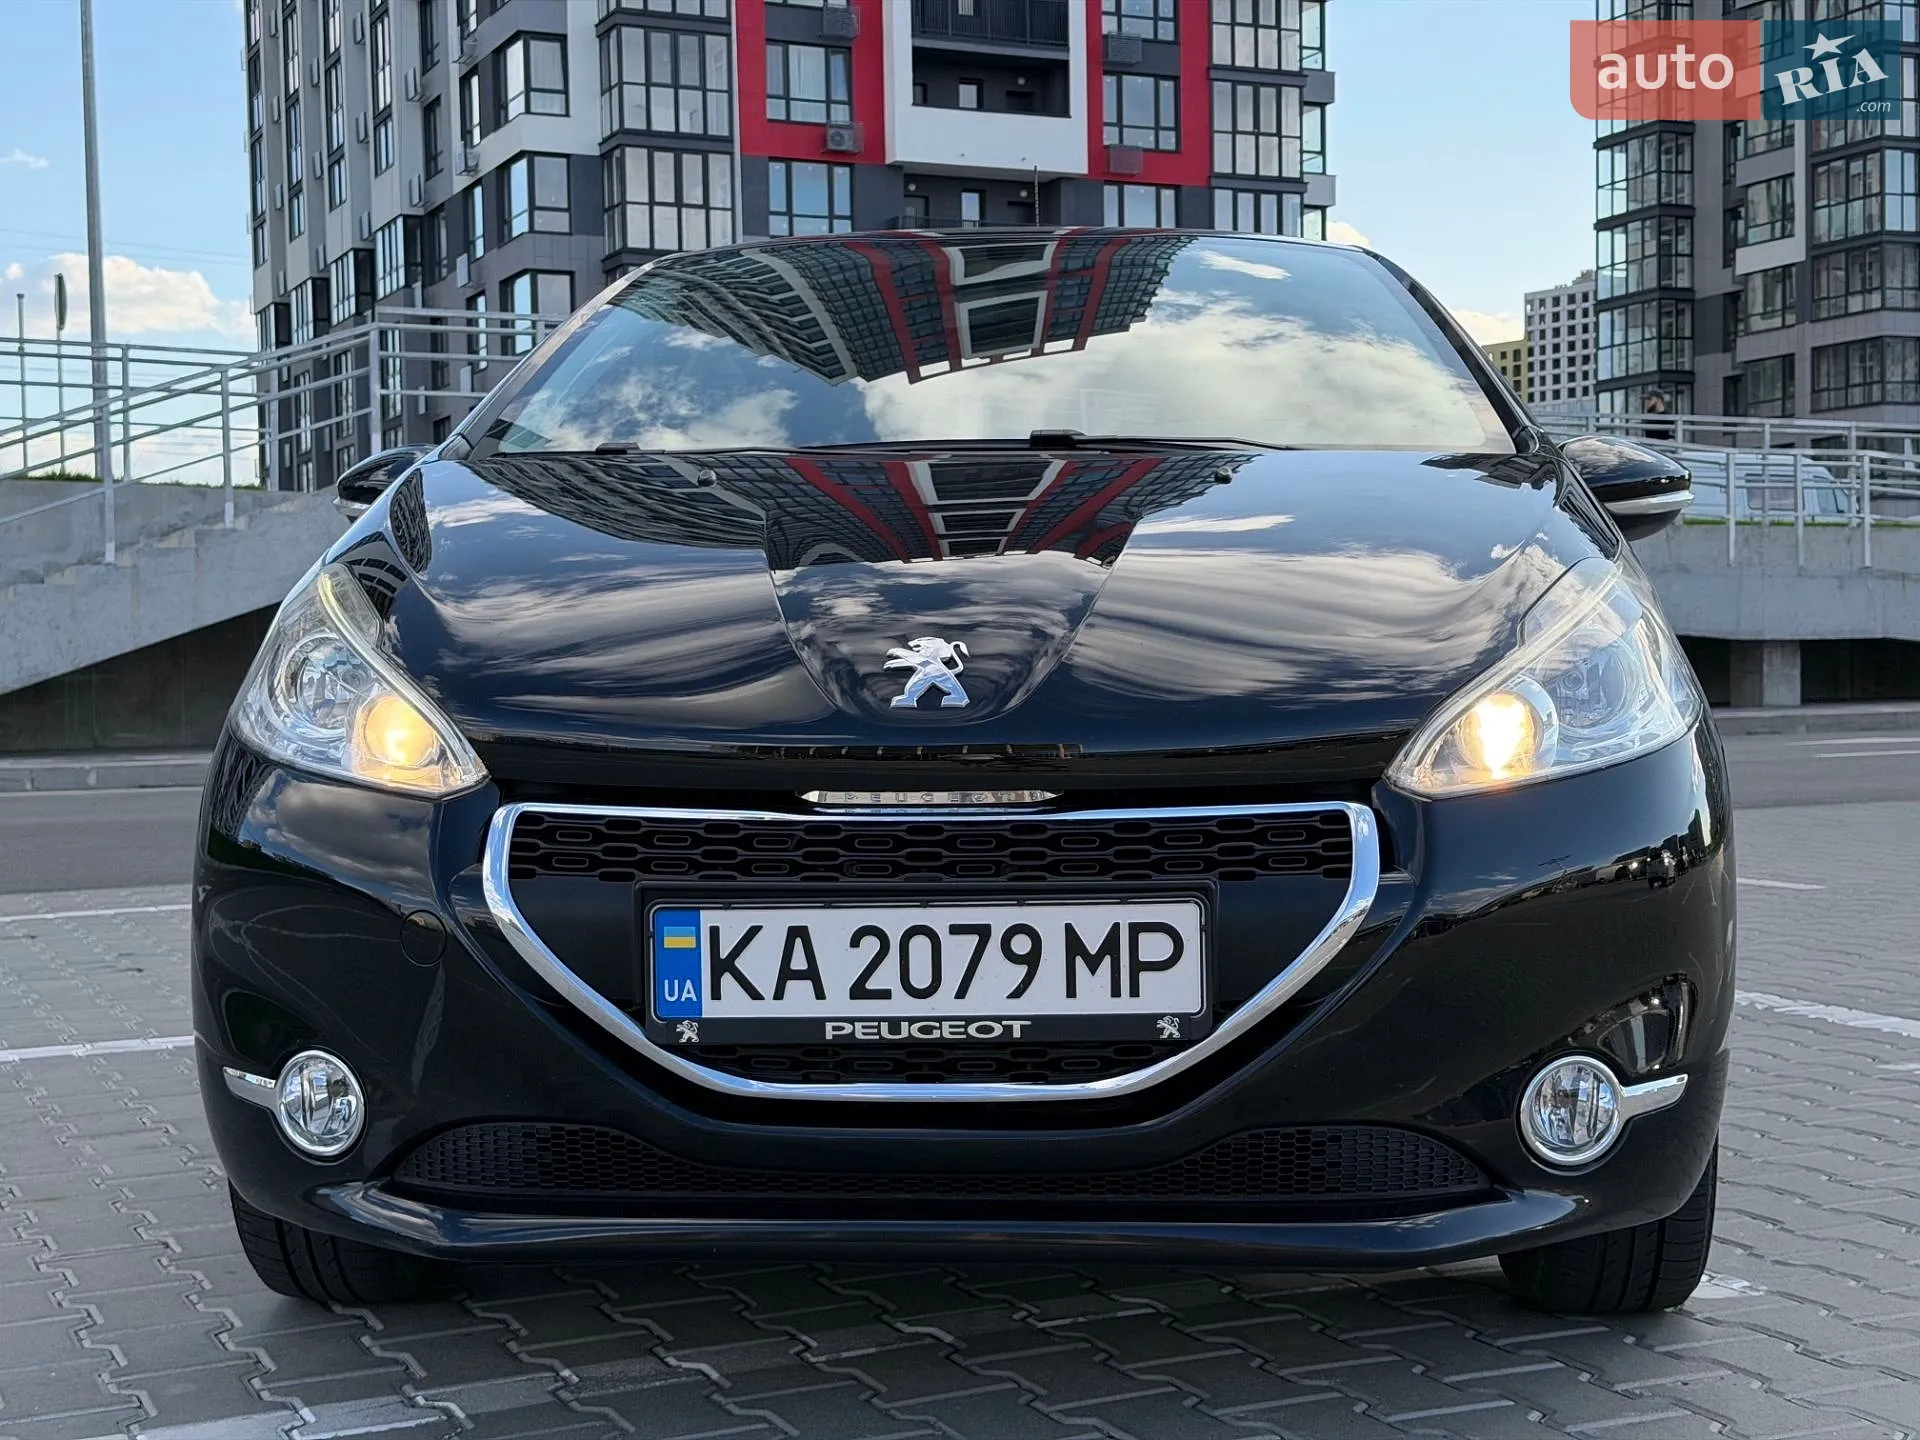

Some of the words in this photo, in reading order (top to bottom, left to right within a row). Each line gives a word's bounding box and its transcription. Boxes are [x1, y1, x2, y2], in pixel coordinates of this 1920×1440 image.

[709, 924, 826, 1001] KA
[849, 922, 1043, 1001] 2079
[1064, 921, 1185, 999] MP
[664, 978, 698, 1002] UA
[825, 1019, 1032, 1040] PEUGEOT
